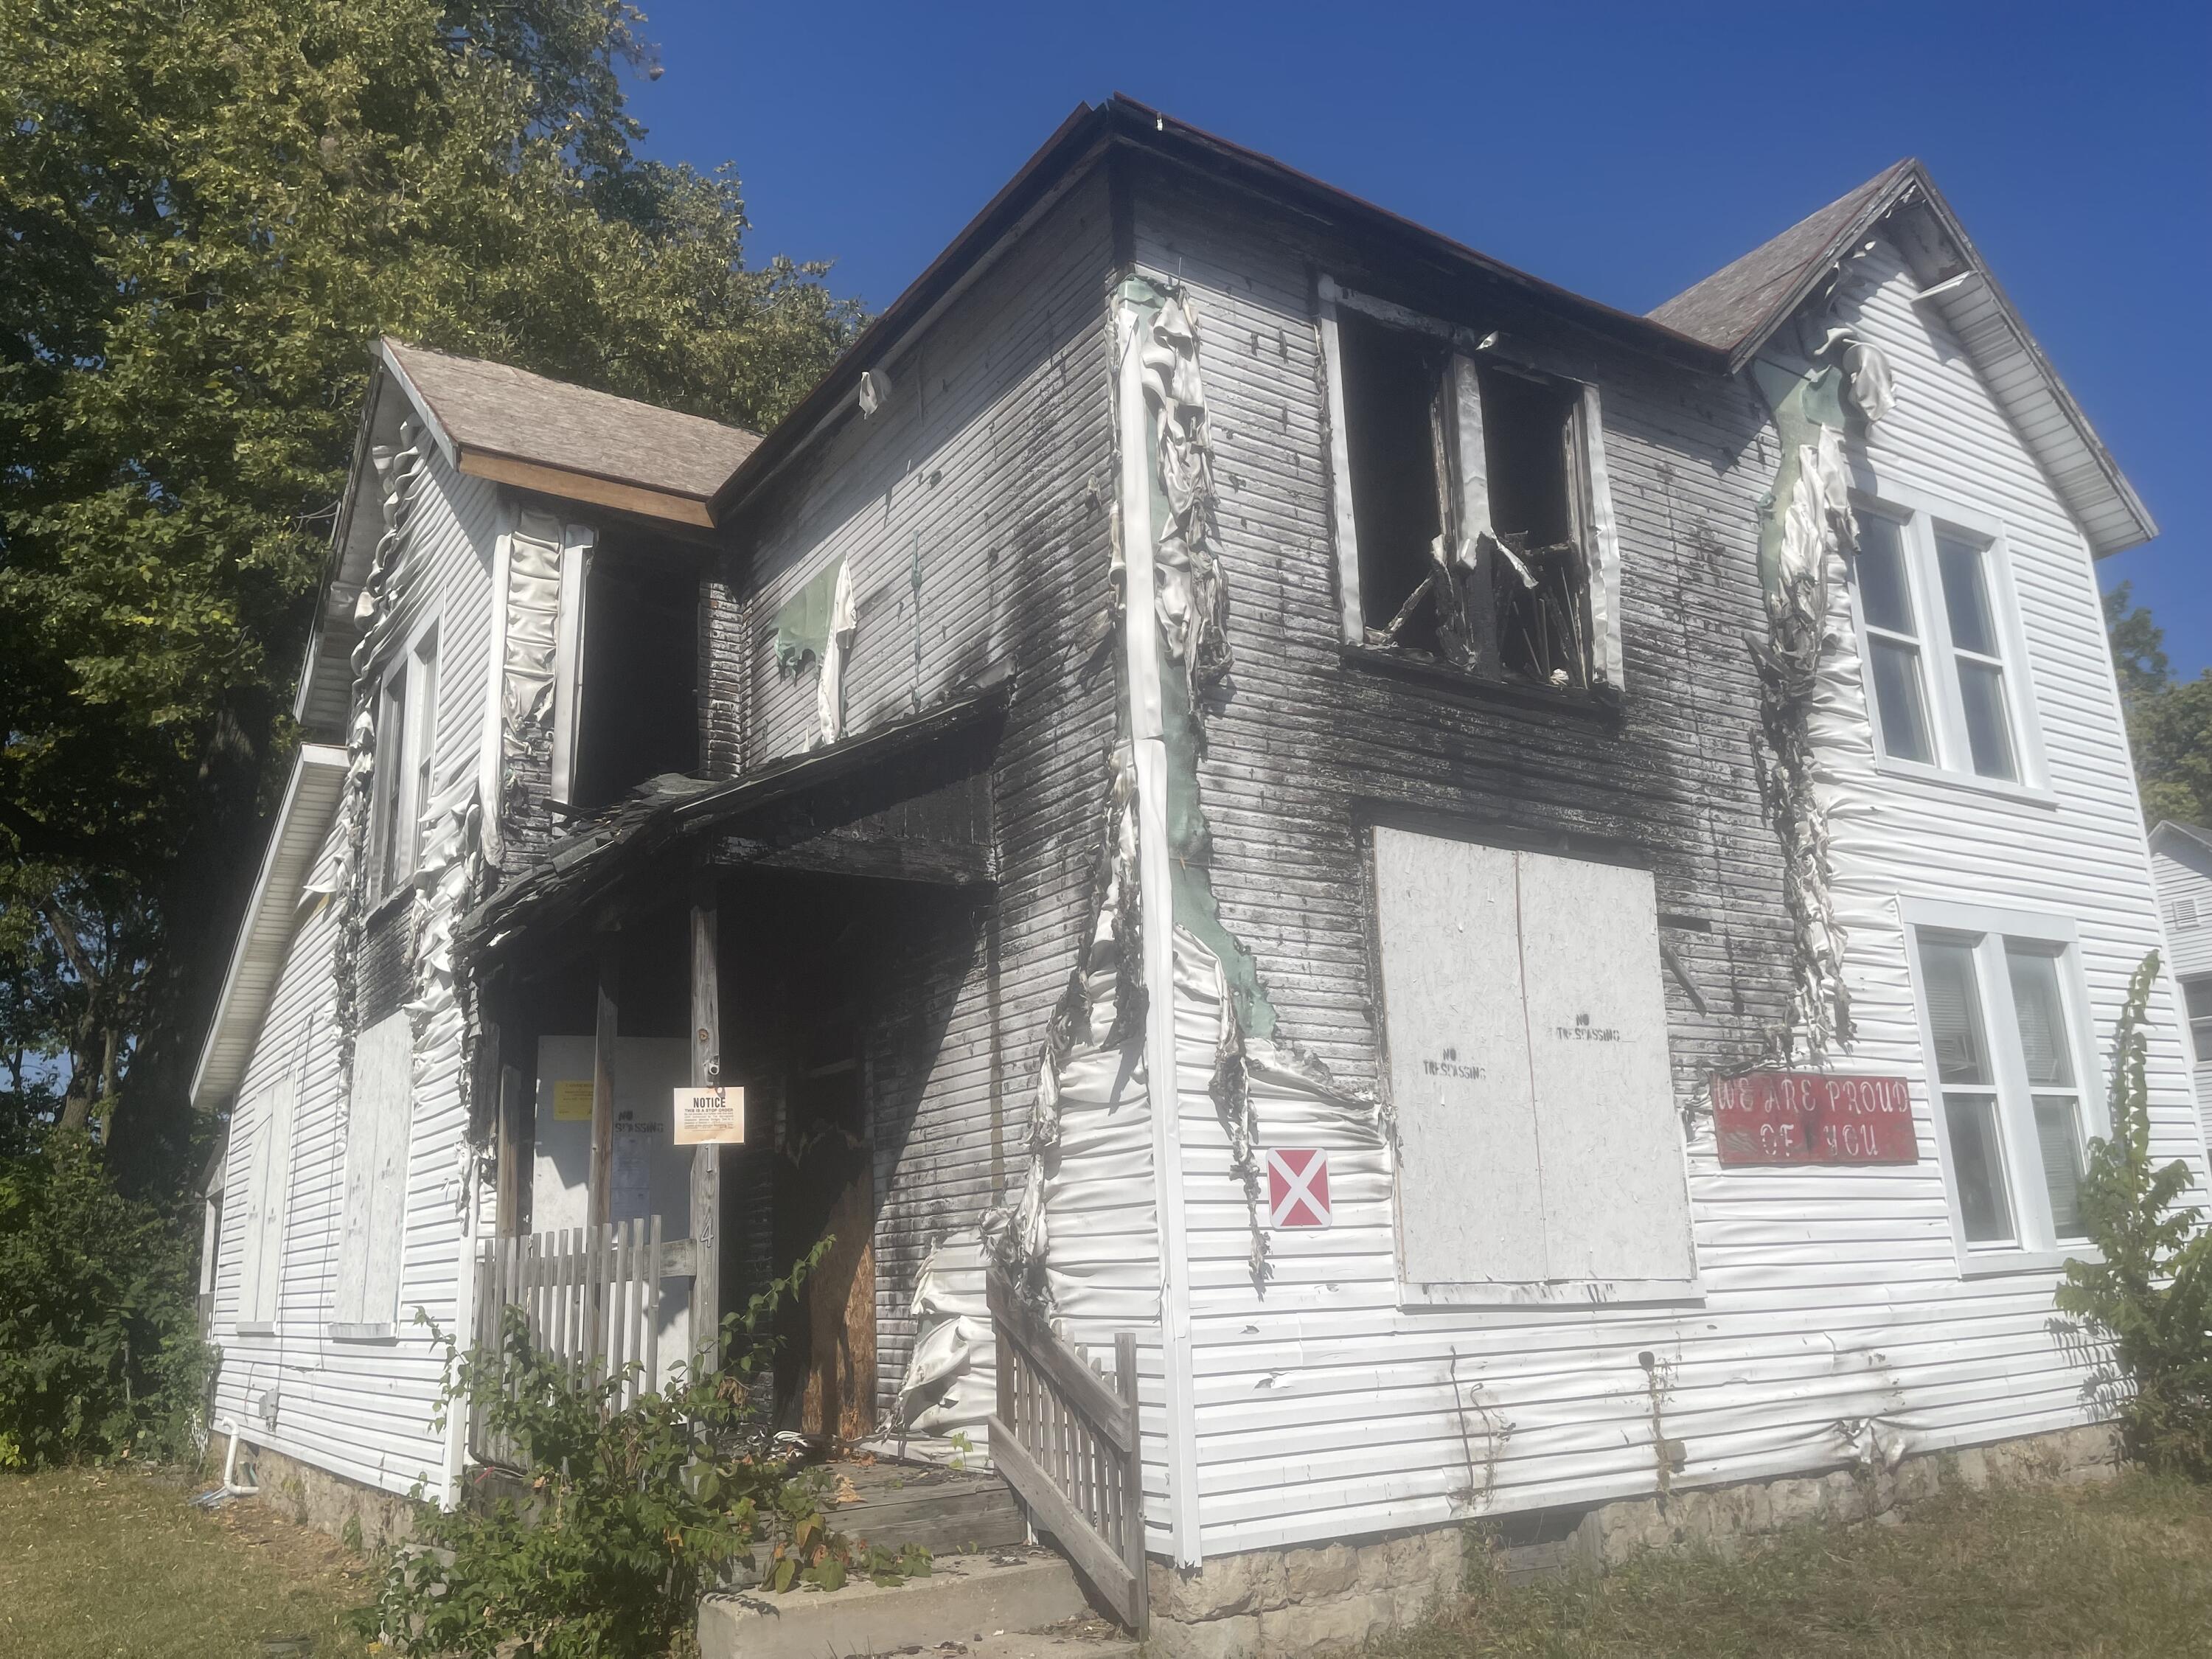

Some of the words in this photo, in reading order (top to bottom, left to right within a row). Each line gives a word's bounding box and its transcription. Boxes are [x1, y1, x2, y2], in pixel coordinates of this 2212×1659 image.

[1576, 1013, 1590, 1026] NO
[1443, 1048, 1456, 1061] NO
[1716, 1077, 1753, 1112] WE
[1764, 1078, 1818, 1113] ARE
[1826, 1080, 1908, 1114] PROUD
[693, 1097, 726, 1108] NOTICE
[619, 1110, 633, 1121] NO
[1760, 1123, 1795, 1157] OF
[1823, 1124, 1879, 1156] YOU
[700, 1217, 714, 1248] 4
